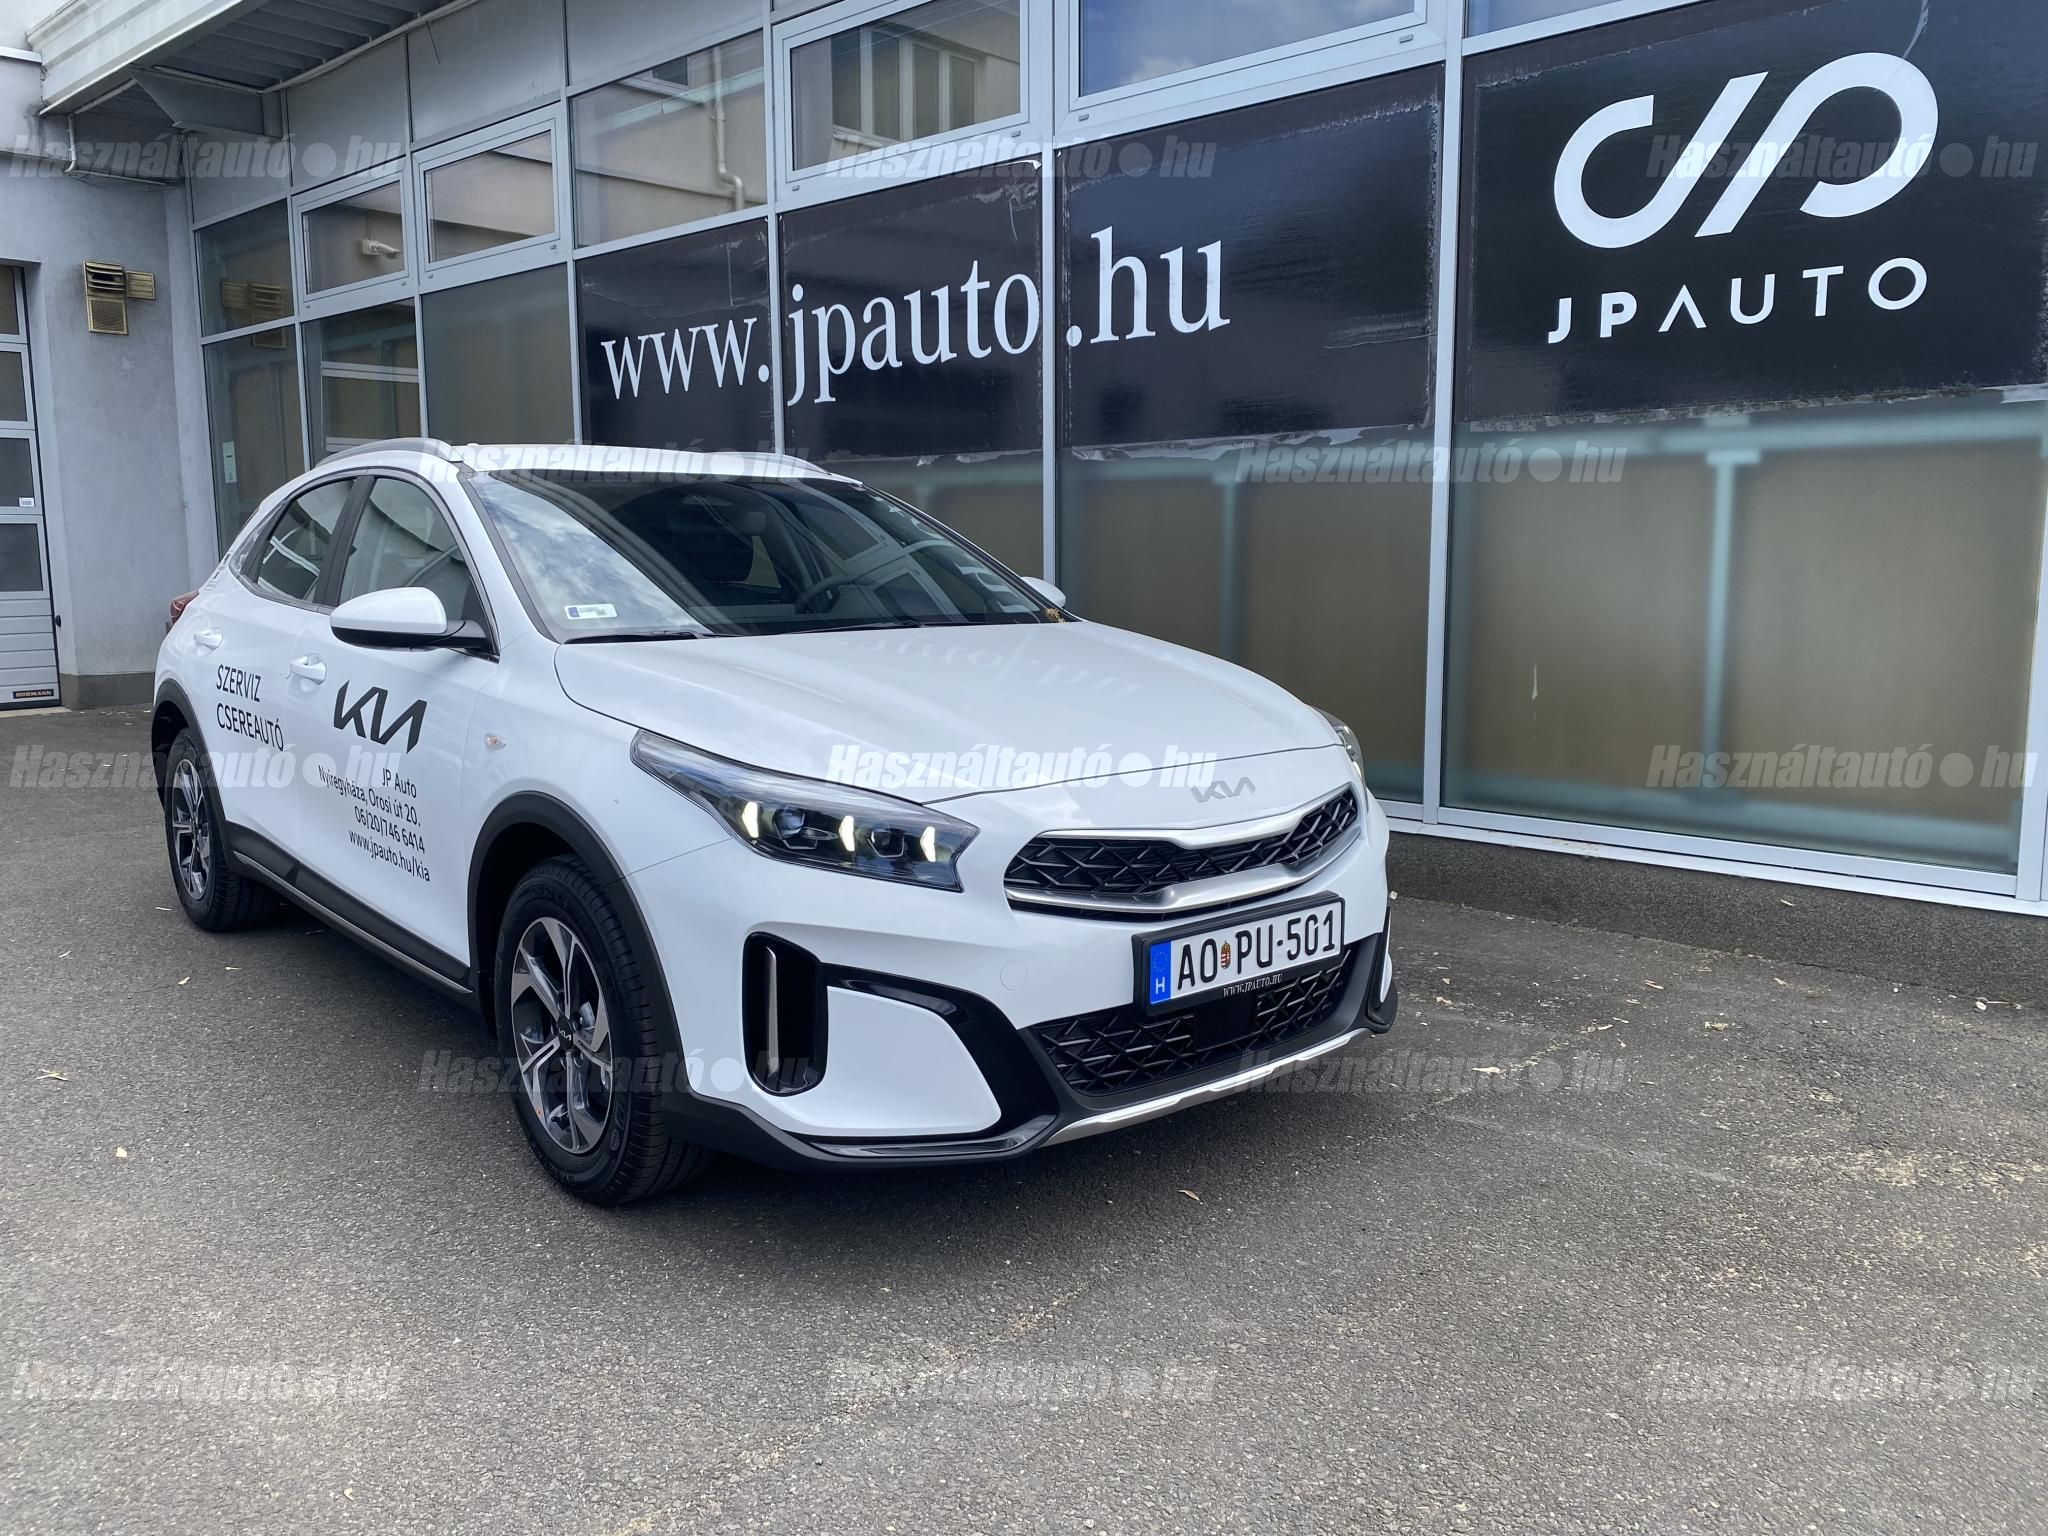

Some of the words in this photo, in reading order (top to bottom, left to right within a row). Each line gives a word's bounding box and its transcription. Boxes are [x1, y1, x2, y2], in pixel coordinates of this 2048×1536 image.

[601, 226, 1230, 405] www.jpauto.hu
[216, 664, 261, 702] SZERVIZ
[217, 702, 284, 751] CSEREAUTÓ
[382, 768, 391, 787] JP
[394, 773, 417, 798] Auto
[368, 788, 393, 812] Orosi
[394, 798, 403, 820] út
[405, 804, 421, 827] 20.
[354, 806, 401, 843] 06/20/746
[402, 829, 425, 854] 6414
[349, 829, 430, 882] www.jpauto.hu/kia
[1177, 938, 1218, 990] AO
[1235, 910, 1336, 975] PU-501
[1155, 976, 1166, 995] H
[1223, 973, 1283, 998] WWW.JPAUTO.HU
